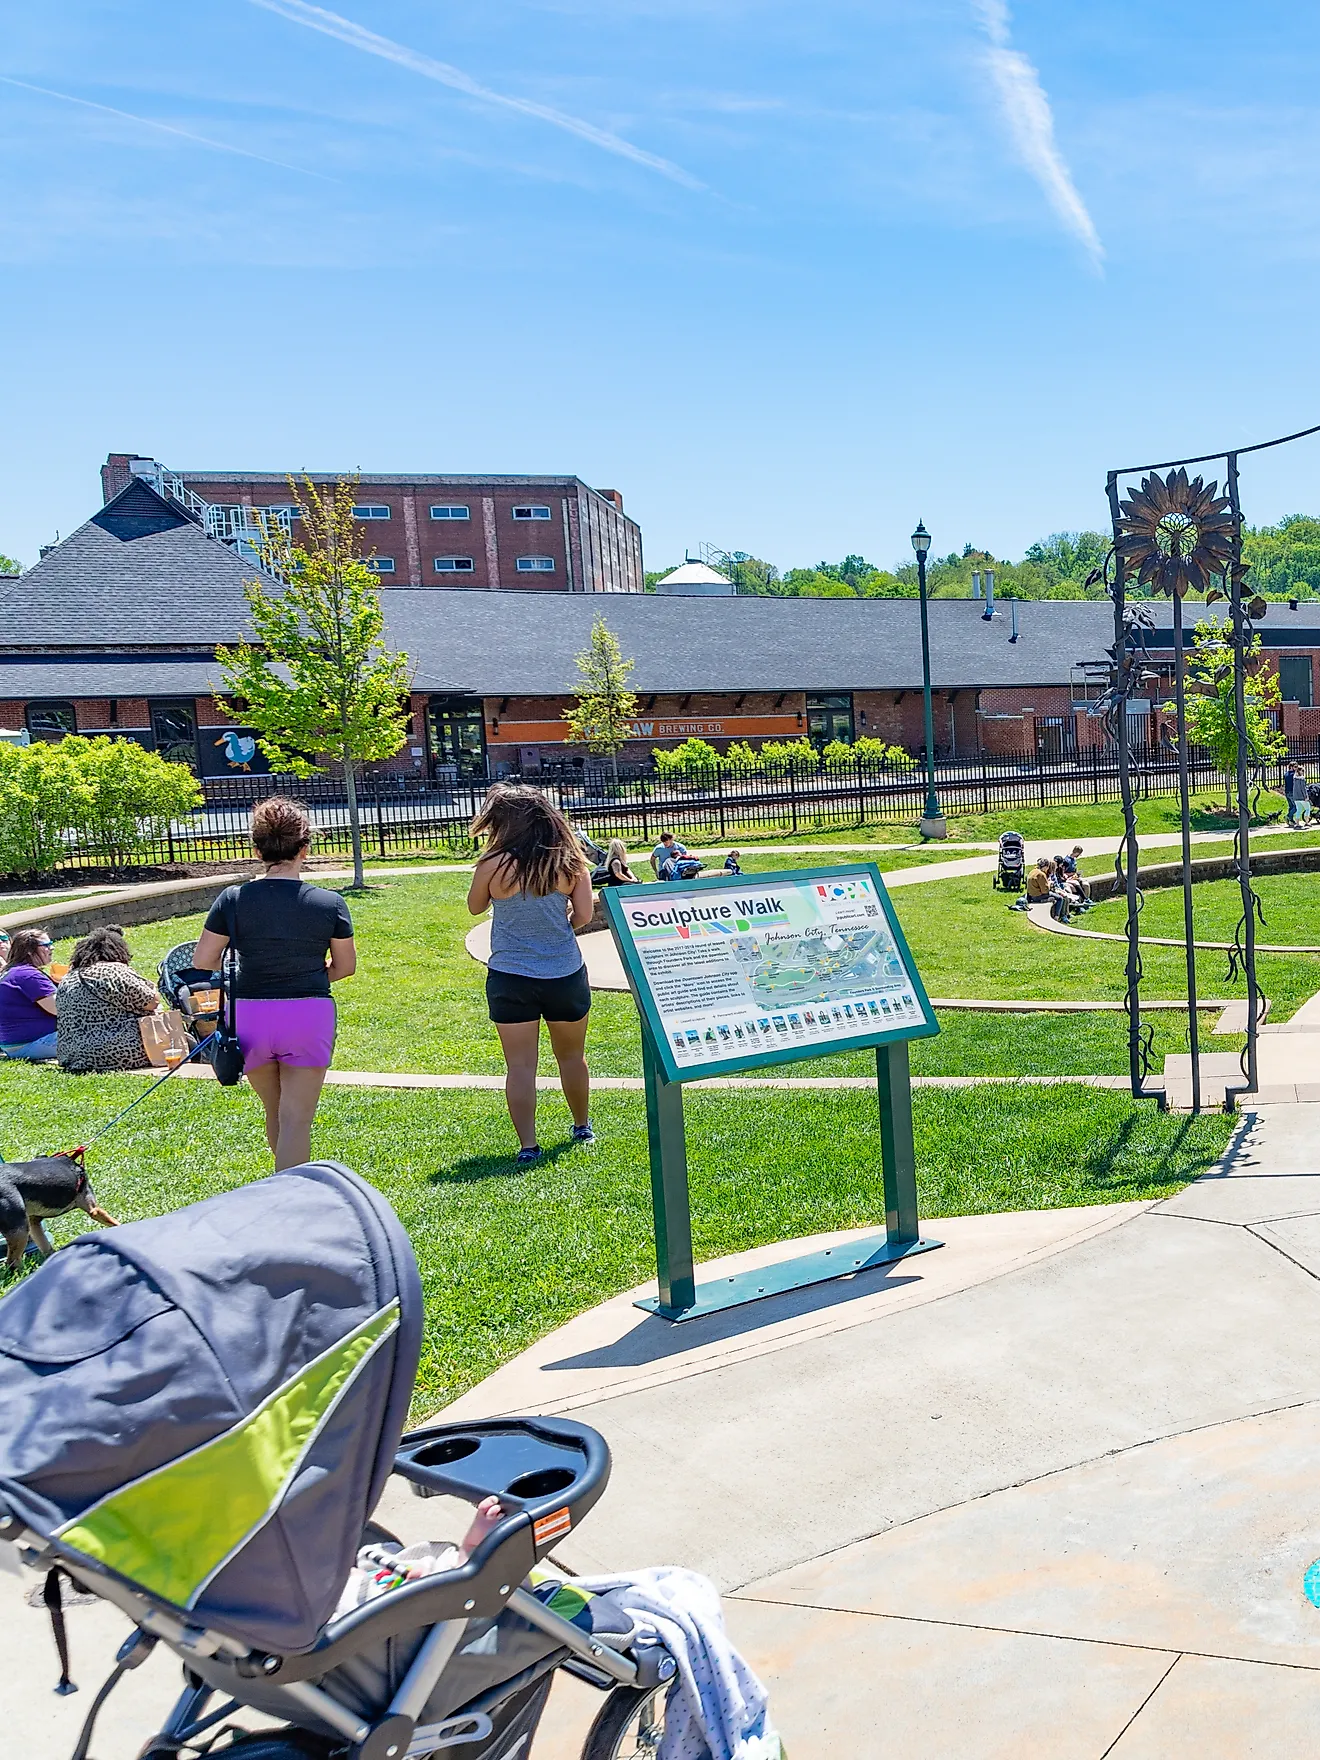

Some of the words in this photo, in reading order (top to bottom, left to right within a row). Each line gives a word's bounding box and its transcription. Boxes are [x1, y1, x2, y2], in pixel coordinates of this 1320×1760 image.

[659, 724, 703, 734] BREWING
[708, 723, 725, 733] CO.
[631, 904, 732, 927] Sculpture
[734, 897, 785, 916] Walk
[765, 932, 801, 945] Johnson
[805, 927, 826, 940] City,
[829, 923, 869, 934] Tennessee
